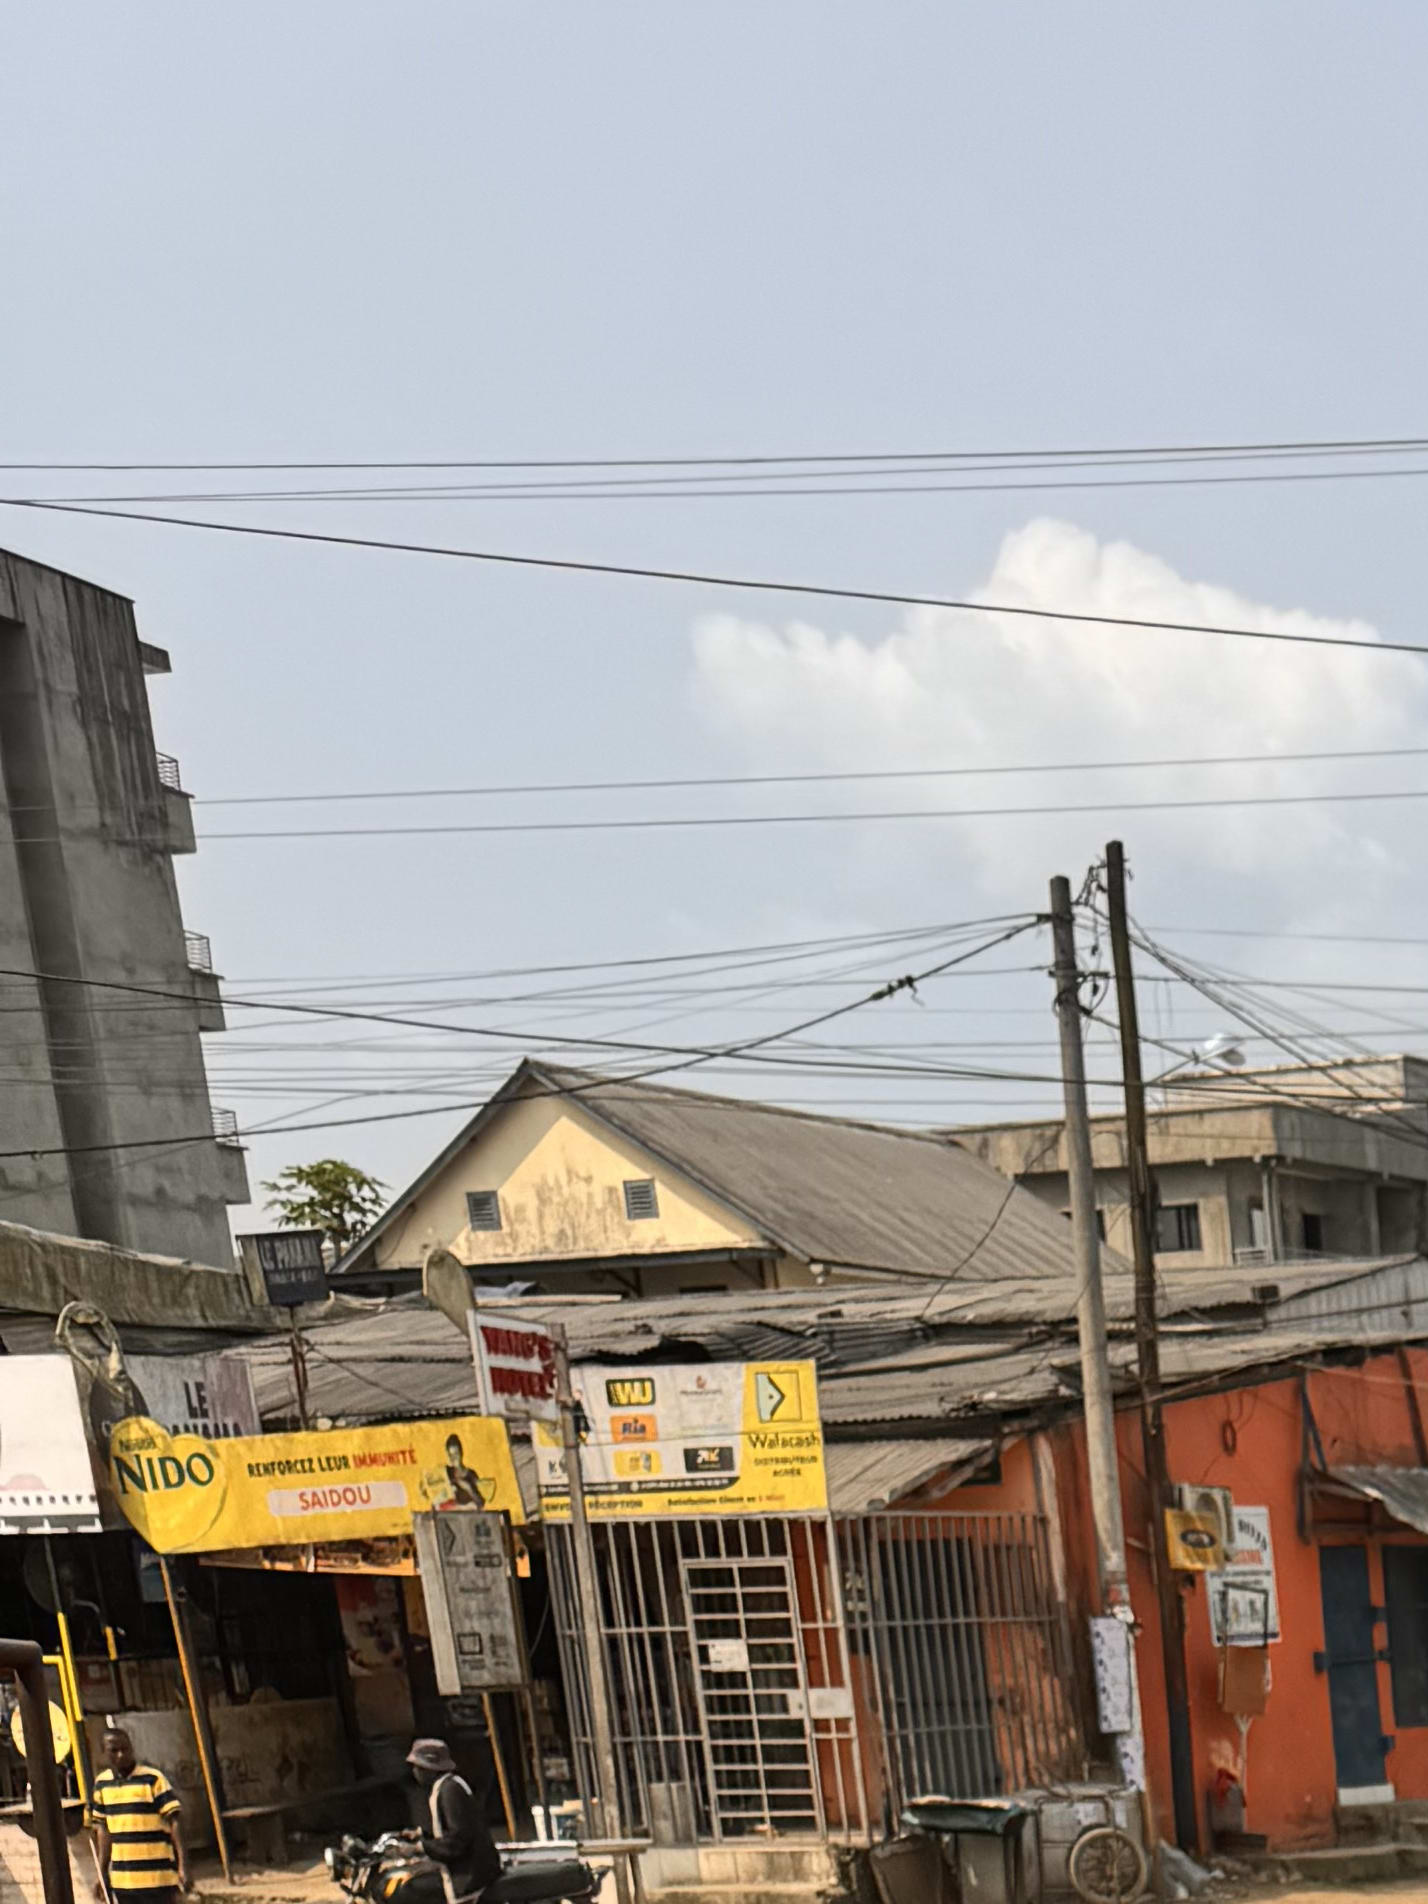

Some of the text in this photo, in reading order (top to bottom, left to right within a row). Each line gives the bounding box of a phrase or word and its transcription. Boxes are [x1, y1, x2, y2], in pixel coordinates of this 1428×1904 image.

[183, 1381, 210, 1419] LE
[113, 1452, 215, 1496] NIDO
[247, 1442, 418, 1479] RENFORCEZ LEUR IMMUNITÉ
[298, 1484, 372, 1512] SAIDOU
